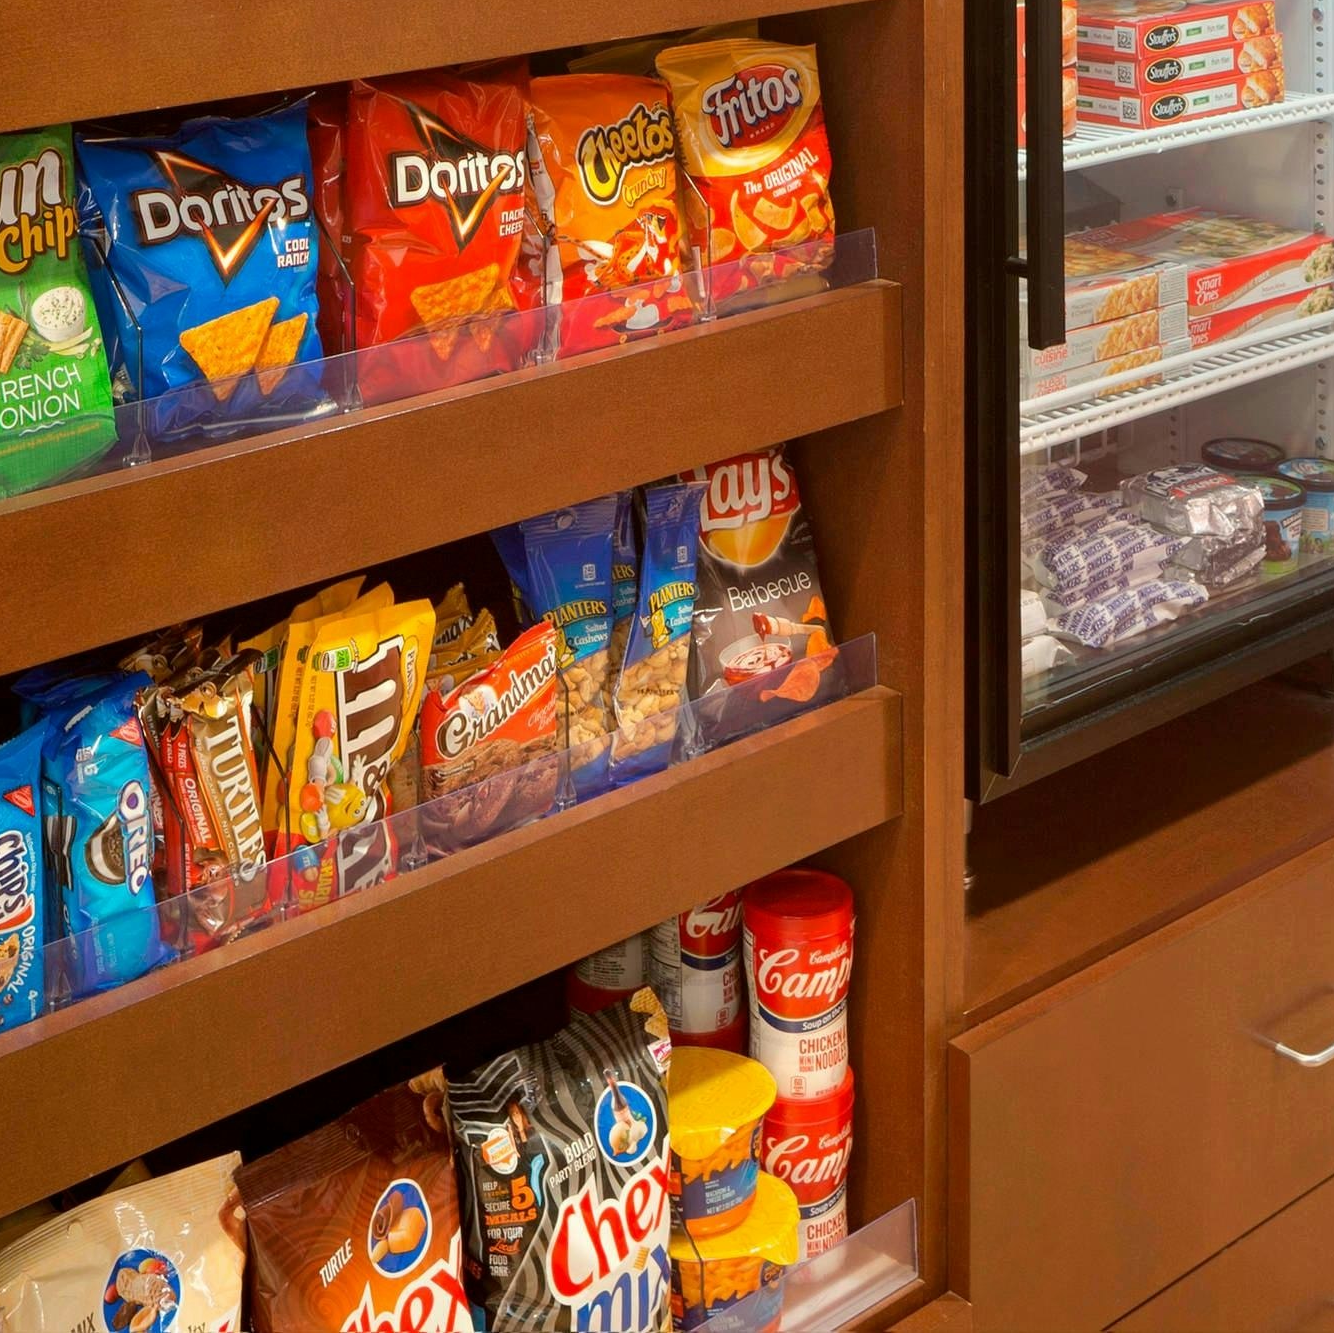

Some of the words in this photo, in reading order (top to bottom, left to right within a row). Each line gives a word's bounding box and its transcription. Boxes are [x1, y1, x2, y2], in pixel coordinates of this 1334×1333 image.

[1148, 29, 1177, 48] Stouffer's
[1149, 63, 1179, 81] Stouffer's
[702, 68, 802, 147] Fritos
[1153, 99, 1184, 116] Stouffer's
[576, 106, 675, 200] Cheetos
[394, 149, 526, 205] Doritos
[621, 166, 668, 208] Crunchy
[743, 181, 763, 195] The
[764, 147, 819, 189] ORIGINAL
[135, 175, 310, 244] Doritos
[276, 249, 310, 268] RANCH
[285, 238, 310, 252] COOL
[1196, 273, 1222, 292] Smart
[1196, 289, 1219, 305] Ones
[650, 582, 695, 612] PLANTERS
[728, 570, 813, 612] Barbecue
[573, 633, 609, 647] Cashews
[585, 622, 607, 632] Salted
[435, 643, 556, 759] Grandma'
[184, 777, 211, 844] ORIGINAL
[205, 715, 267, 882] TURTLES
[118, 779, 148, 897] OREO
[7, 924, 35, 993] ORIGINAL
[759, 948, 851, 1003] Camp
[803, 1020, 823, 1030] Soup
[799, 1033, 842, 1054] CHICKEN
[563, 1131, 595, 1164] BOLD
[549, 1165, 573, 1188] PARTY
[574, 1148, 597, 1172] BLEND
[482, 1181, 498, 1191] HELP
[511, 1175, 535, 1210] 5
[485, 1200, 511, 1212] SECURE
[485, 1208, 538, 1226] MEALS
[487, 1228, 502, 1239] FOR
[551, 1156, 671, 1298] Chex
[318, 1238, 353, 1288] TURTLE
[489, 1254, 508, 1266] FOOD
